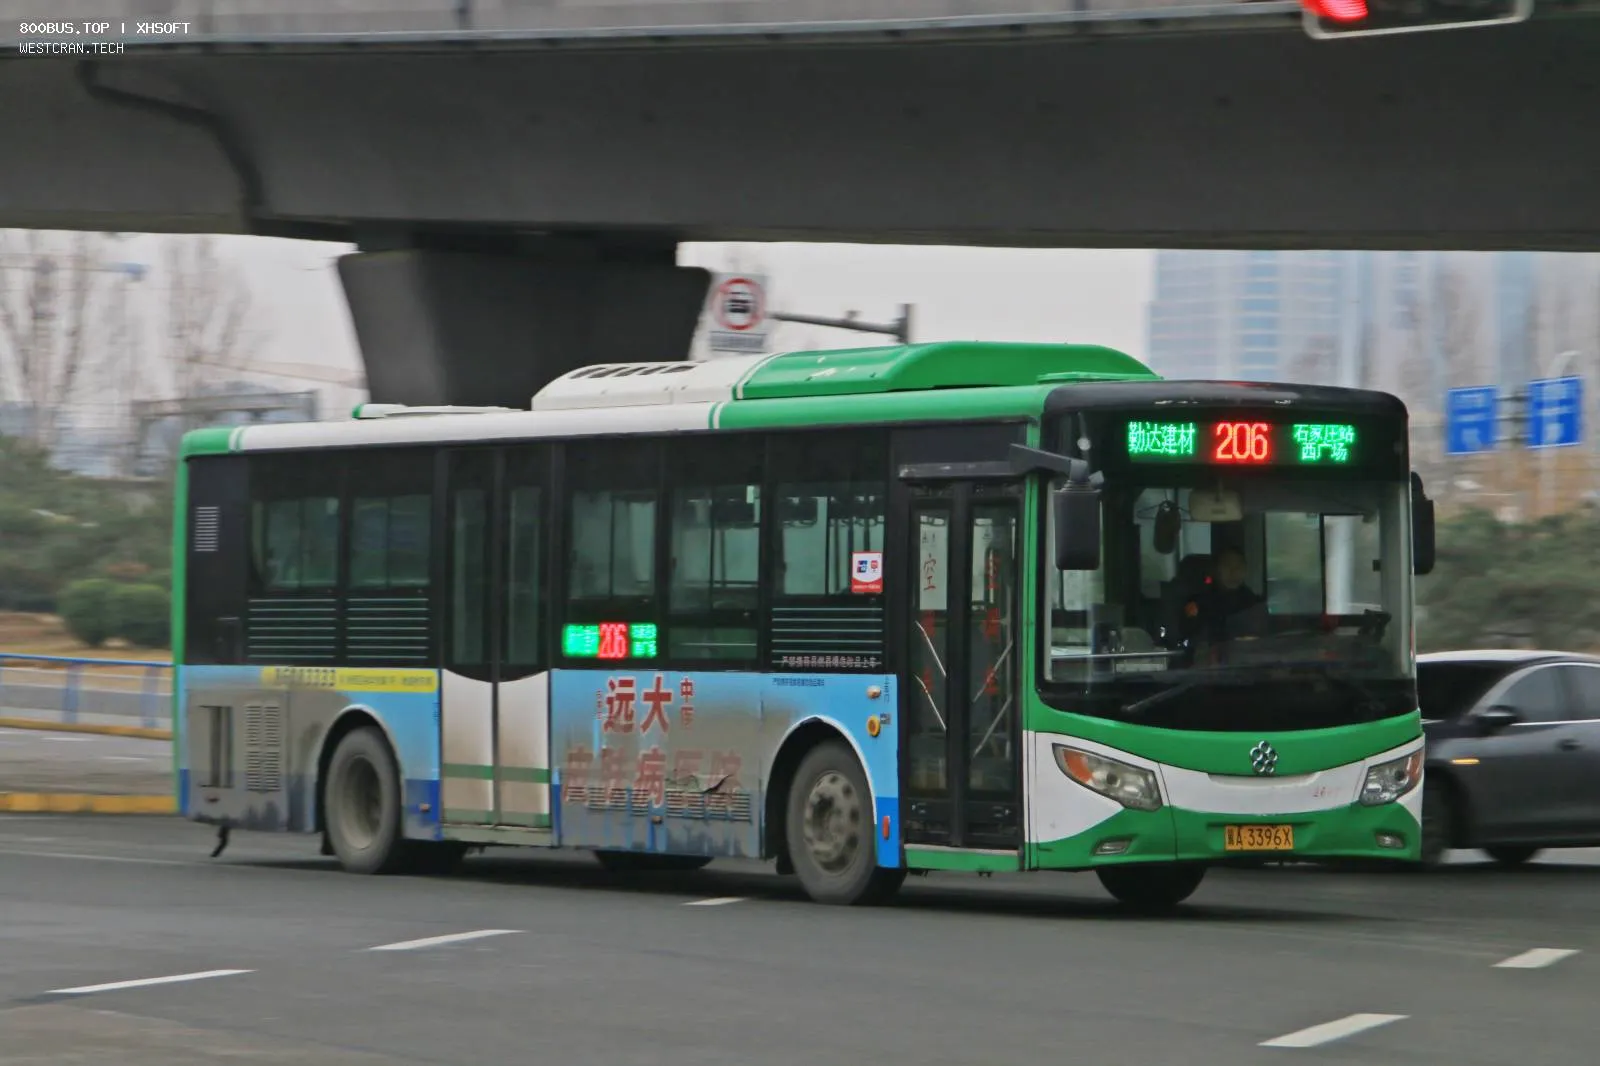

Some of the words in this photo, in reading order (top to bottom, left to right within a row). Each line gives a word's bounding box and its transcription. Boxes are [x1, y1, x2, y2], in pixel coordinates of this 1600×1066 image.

[1127, 421, 1196, 454] 勤达建材
[1215, 422, 1270, 460] 206
[1292, 423, 1355, 443] 石家庄站
[1301, 442, 1349, 461] 西广场
[598, 622, 628, 659] 206
[602, 675, 674, 735] 远大
